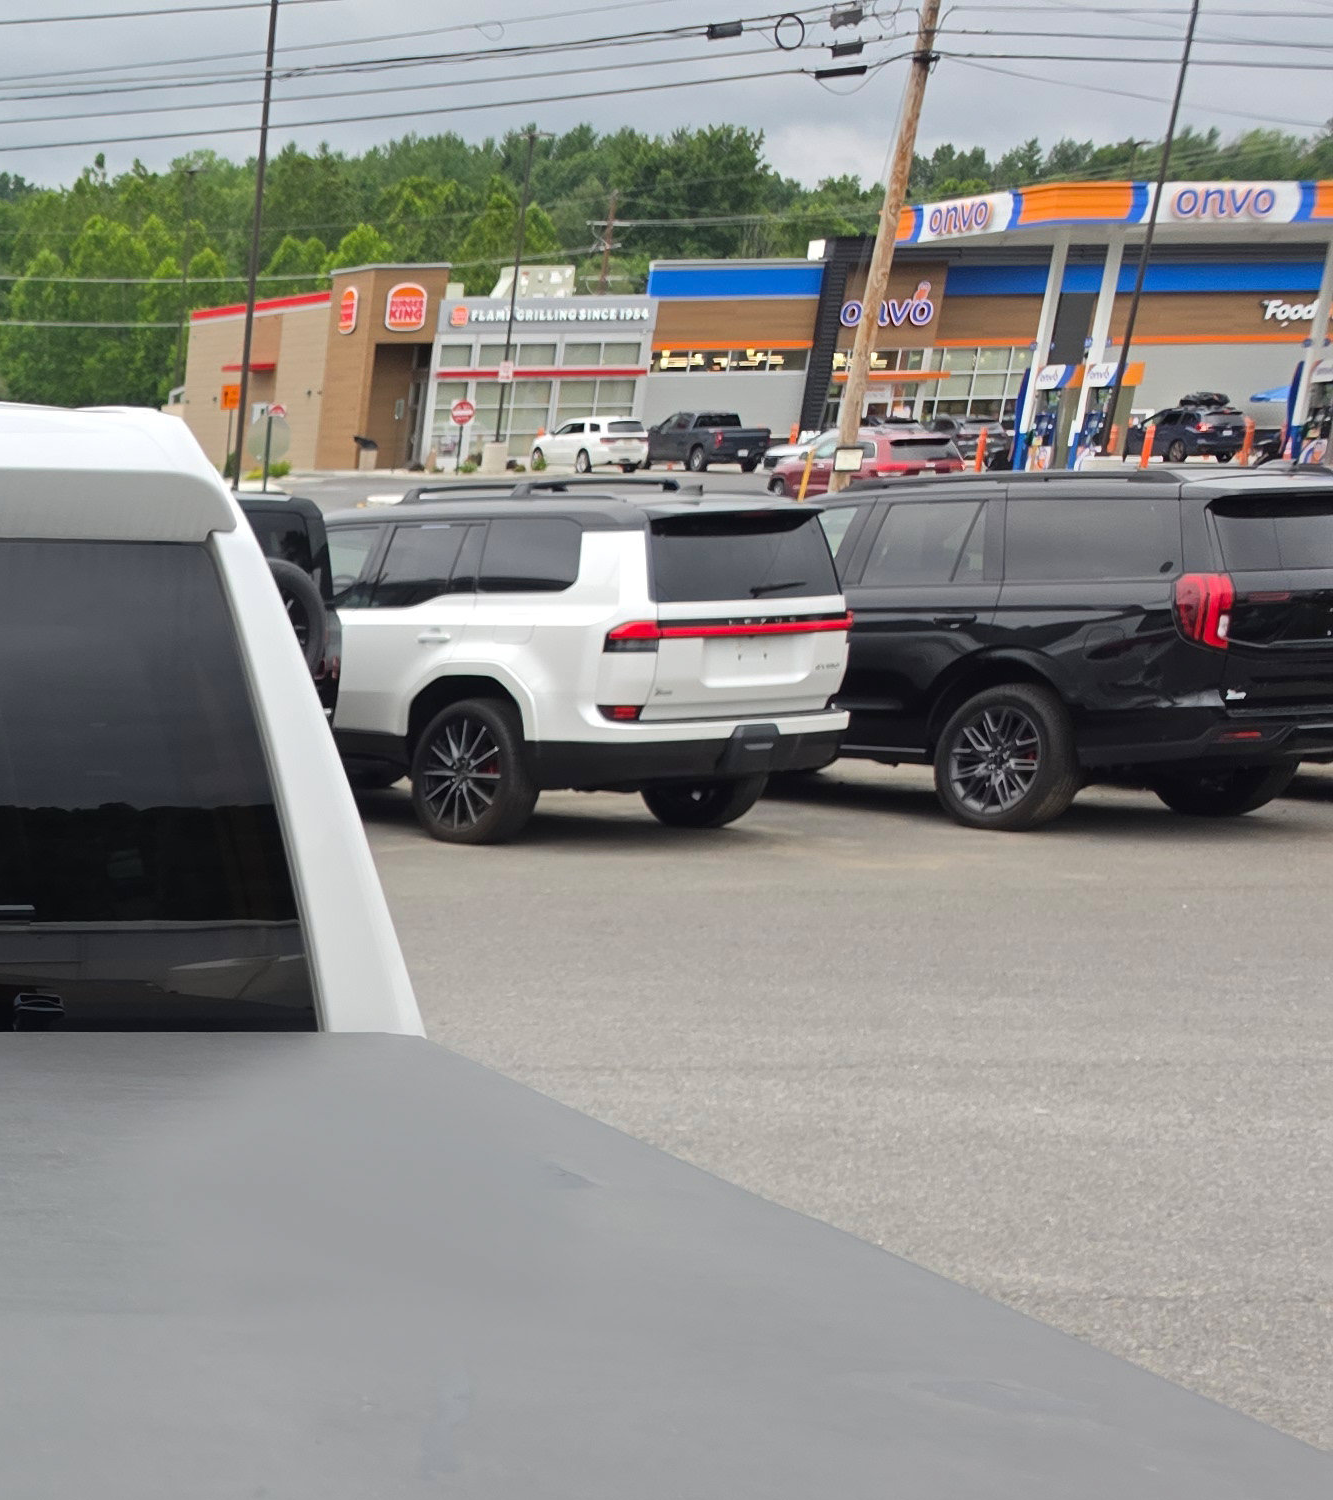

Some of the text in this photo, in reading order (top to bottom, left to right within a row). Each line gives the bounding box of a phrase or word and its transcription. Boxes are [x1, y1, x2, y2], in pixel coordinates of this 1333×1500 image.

[1174, 188, 1276, 217] onvo
[928, 199, 991, 235] onvo
[389, 309, 422, 321] KING
[516, 308, 574, 321] GRILLING
[578, 307, 617, 321] SINCE
[1261, 299, 1319, 321] Food
